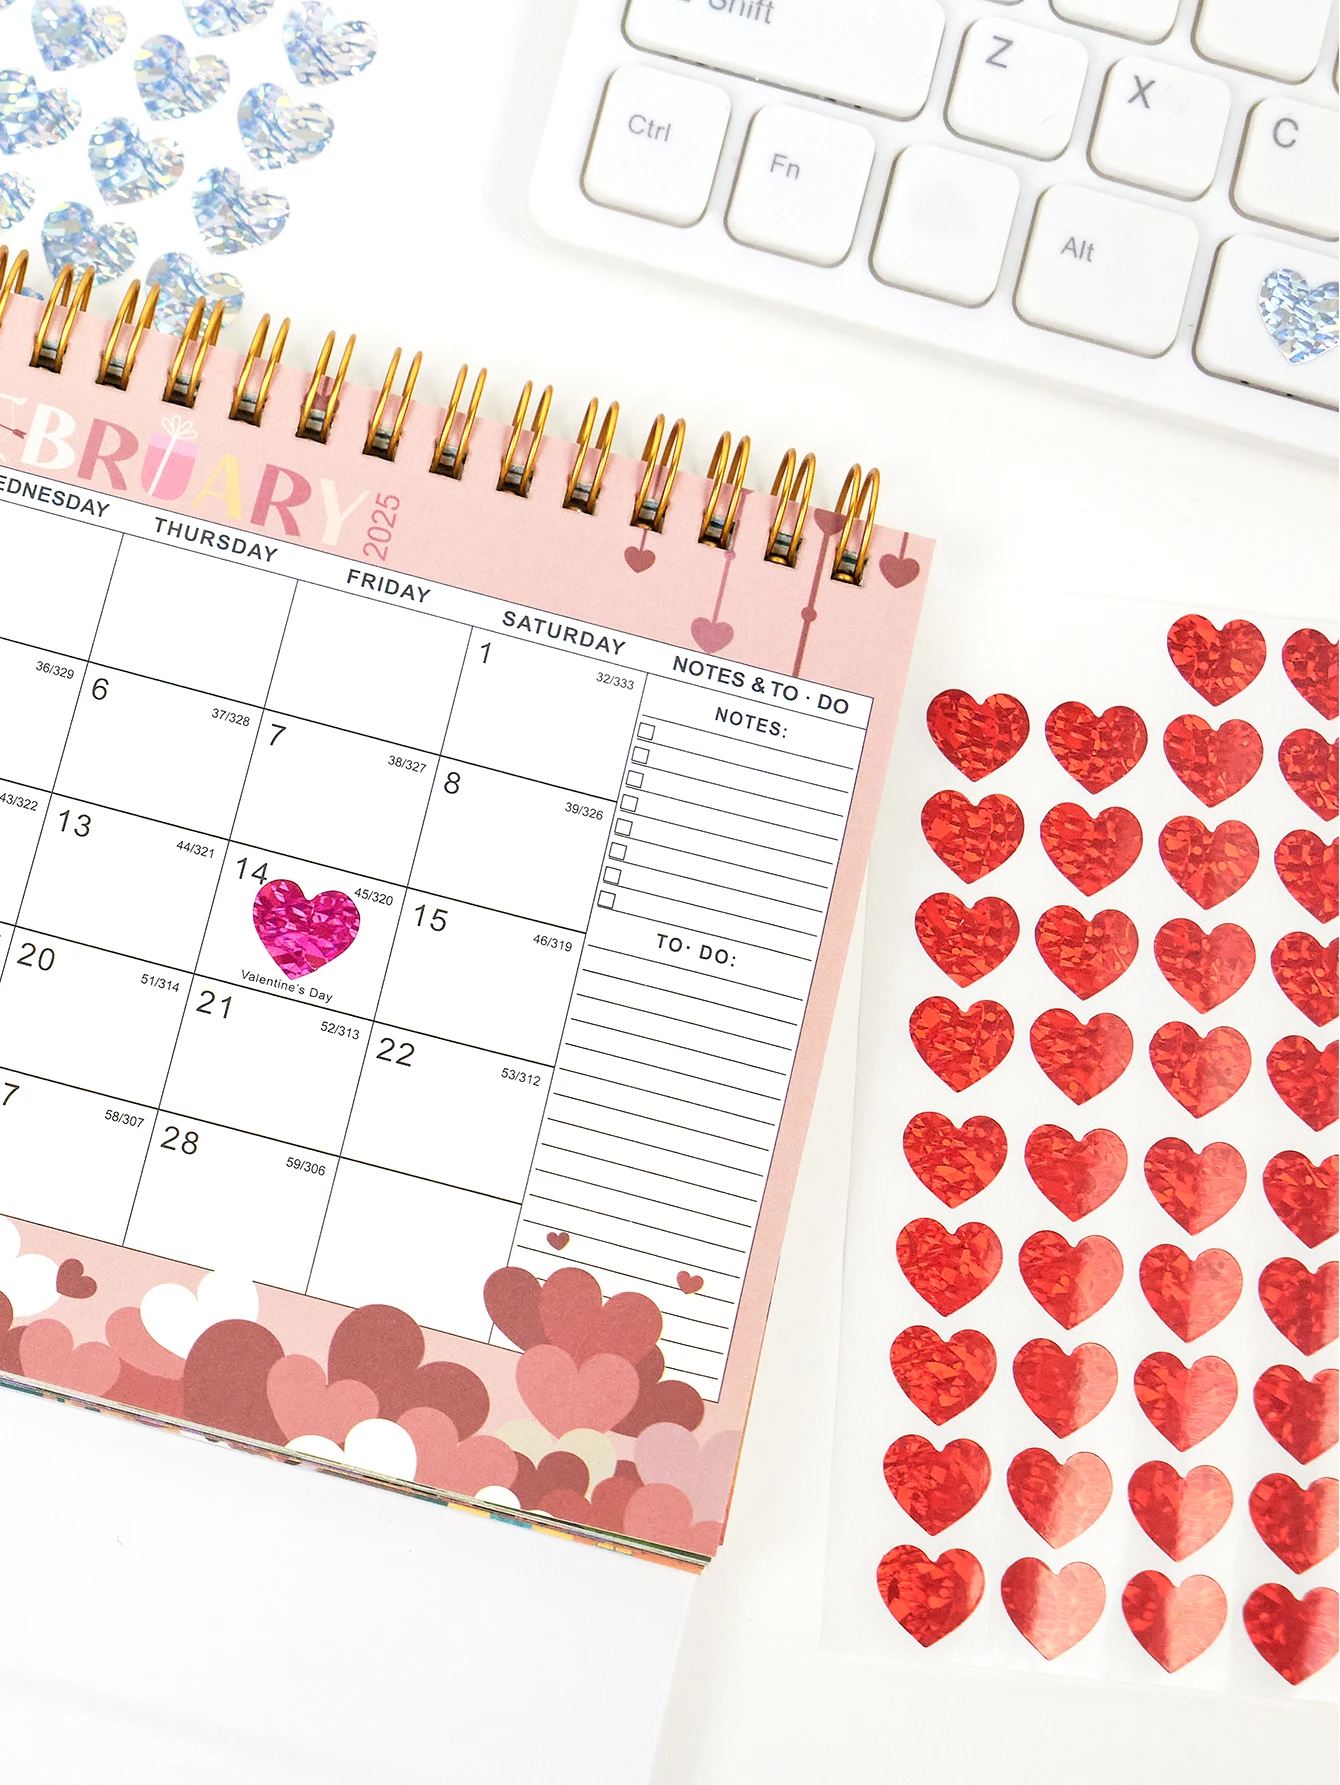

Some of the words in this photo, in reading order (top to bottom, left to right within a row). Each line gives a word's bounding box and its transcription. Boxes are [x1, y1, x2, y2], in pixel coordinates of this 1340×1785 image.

[986, 36, 1013, 68] Z
[1128, 75, 1155, 109] X
[629, 115, 671, 141] Ctrl
[1273, 118, 1298, 148] C
[770, 153, 800, 179] Fn
[1061, 237, 1094, 262] Alt
[0, 392, 370, 546] BRUARY
[0, 475, 110, 518] EDNESDAY
[155, 517, 278, 563] THURSDAY
[363, 493, 401, 562] 2025
[347, 569, 431, 604] FRIDAY
[502, 610, 626, 656] SATURDAY
[481, 643, 490, 663] 1
[36, 661, 75, 680] 36/329
[596, 672, 635, 691] 32/333
[92, 678, 109, 700] 6
[673, 655, 745, 687] NOTES
[752, 677, 764, 693] &
[818, 694, 848, 714] DO
[211, 708, 251, 727] 37/328
[715, 707, 788, 738] NOTES:
[270, 724, 286, 745] 7
[388, 755, 427, 773] 38/327
[444, 772, 460, 794] 8
[0, 793, 38, 811] 43/322
[565, 802, 603, 820] 39/326
[60, 810, 91, 837] 13
[177, 841, 214, 858] 44/321
[236, 857, 268, 885] 14
[354, 887, 394, 906] 45/320
[415, 905, 448, 931] 15
[533, 935, 572, 952] 46/319
[17, 943, 54, 971] 20
[141, 974, 179, 992] 51/314
[241, 969, 305, 995] Valentine's
[309, 988, 333, 1004] Day
[196, 991, 231, 1018] 21
[321, 1021, 359, 1039] 52/313
[376, 1038, 414, 1067] 22
[501, 1067, 541, 1087] 53/312
[105, 1110, 144, 1127] 58/307
[161, 1126, 198, 1154] 28
[286, 1157, 325, 1176] 59/306
